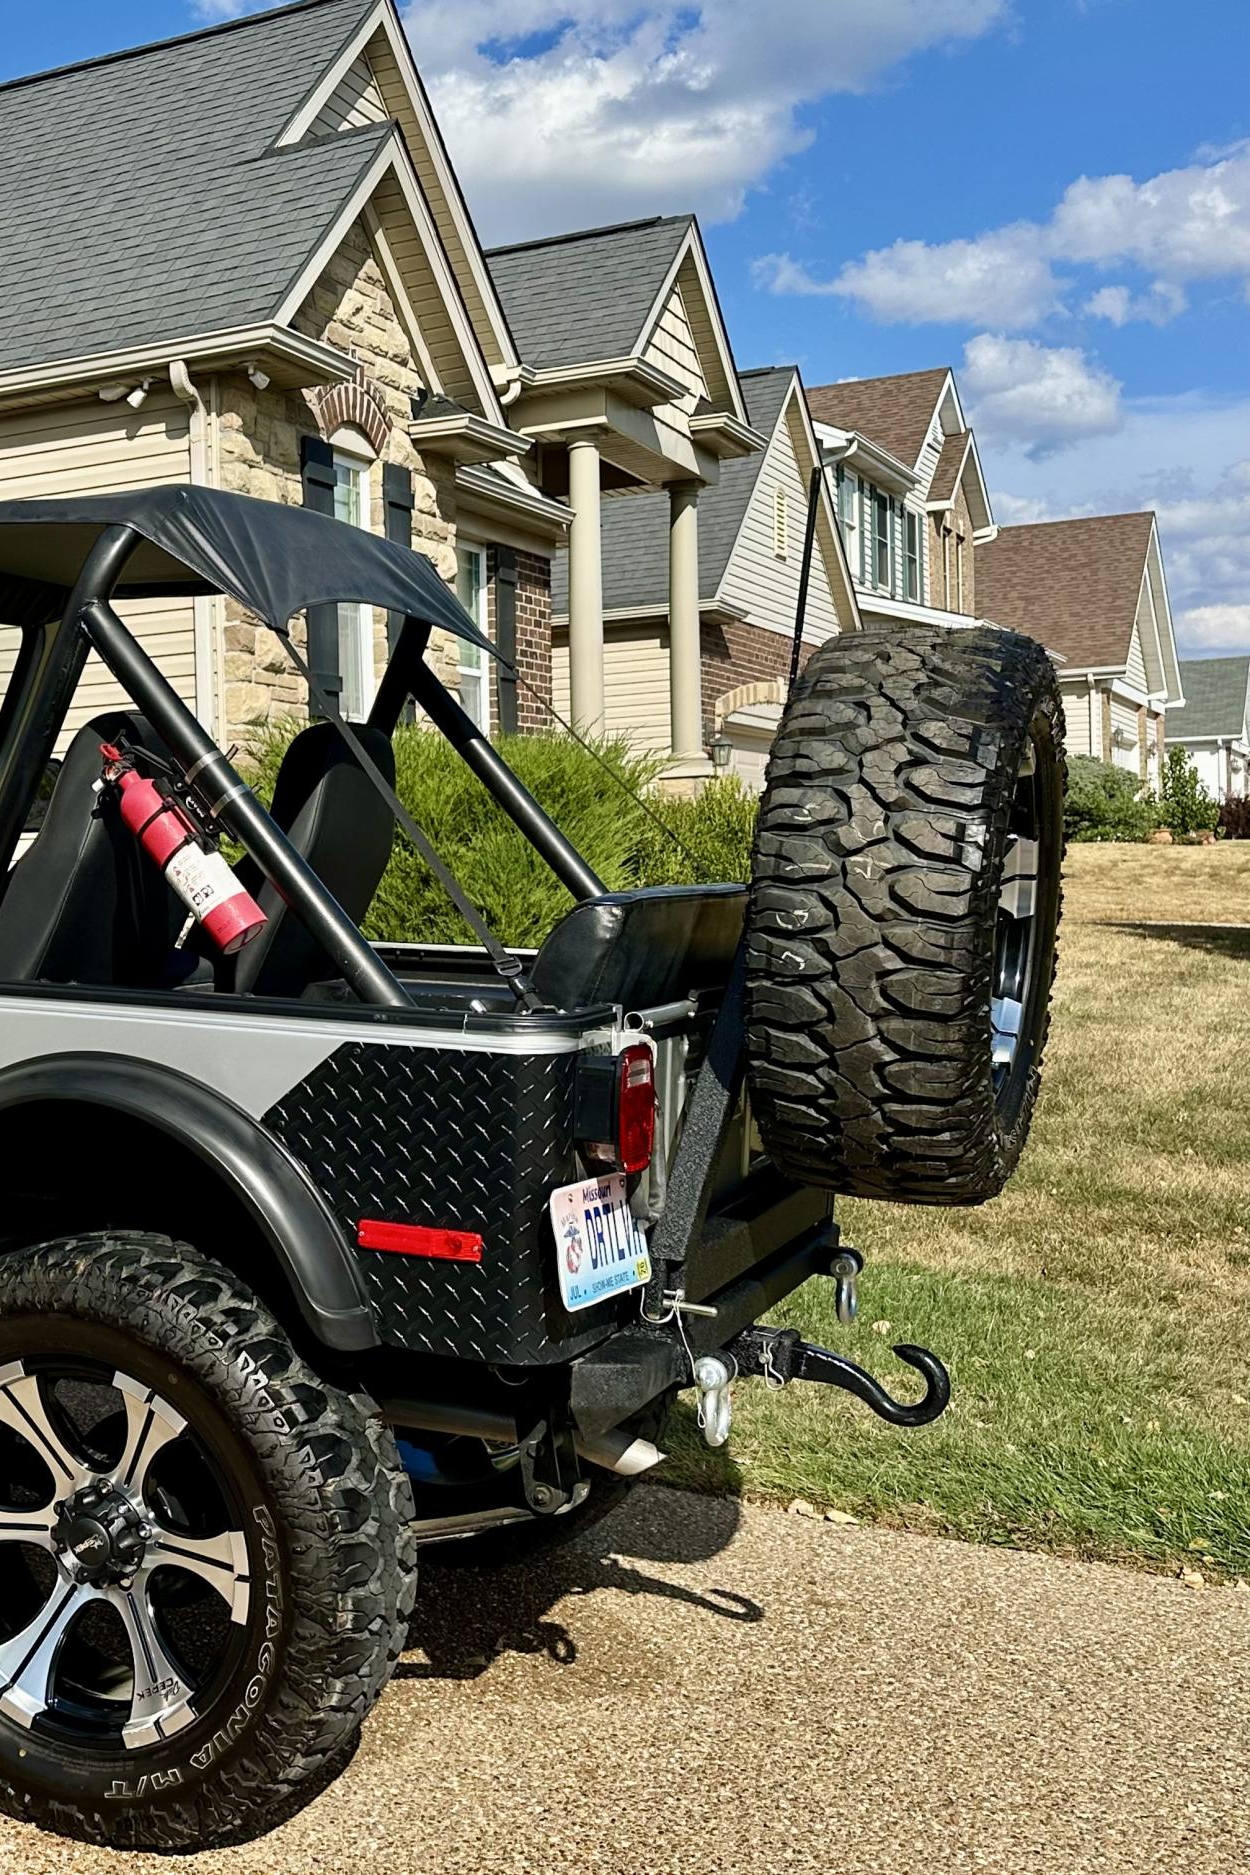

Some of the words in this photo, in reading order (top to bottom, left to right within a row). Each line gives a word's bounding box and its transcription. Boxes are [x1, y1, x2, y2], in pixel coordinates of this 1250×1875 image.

[582, 1181, 612, 1204] Missouri
[614, 1271, 630, 1285] STATE
[570, 1285, 582, 1300] JUL
[190, 1504, 284, 1770] PATAGONIA
[137, 1678, 174, 1701] CEPEK
[104, 1768, 184, 1799] M/T
